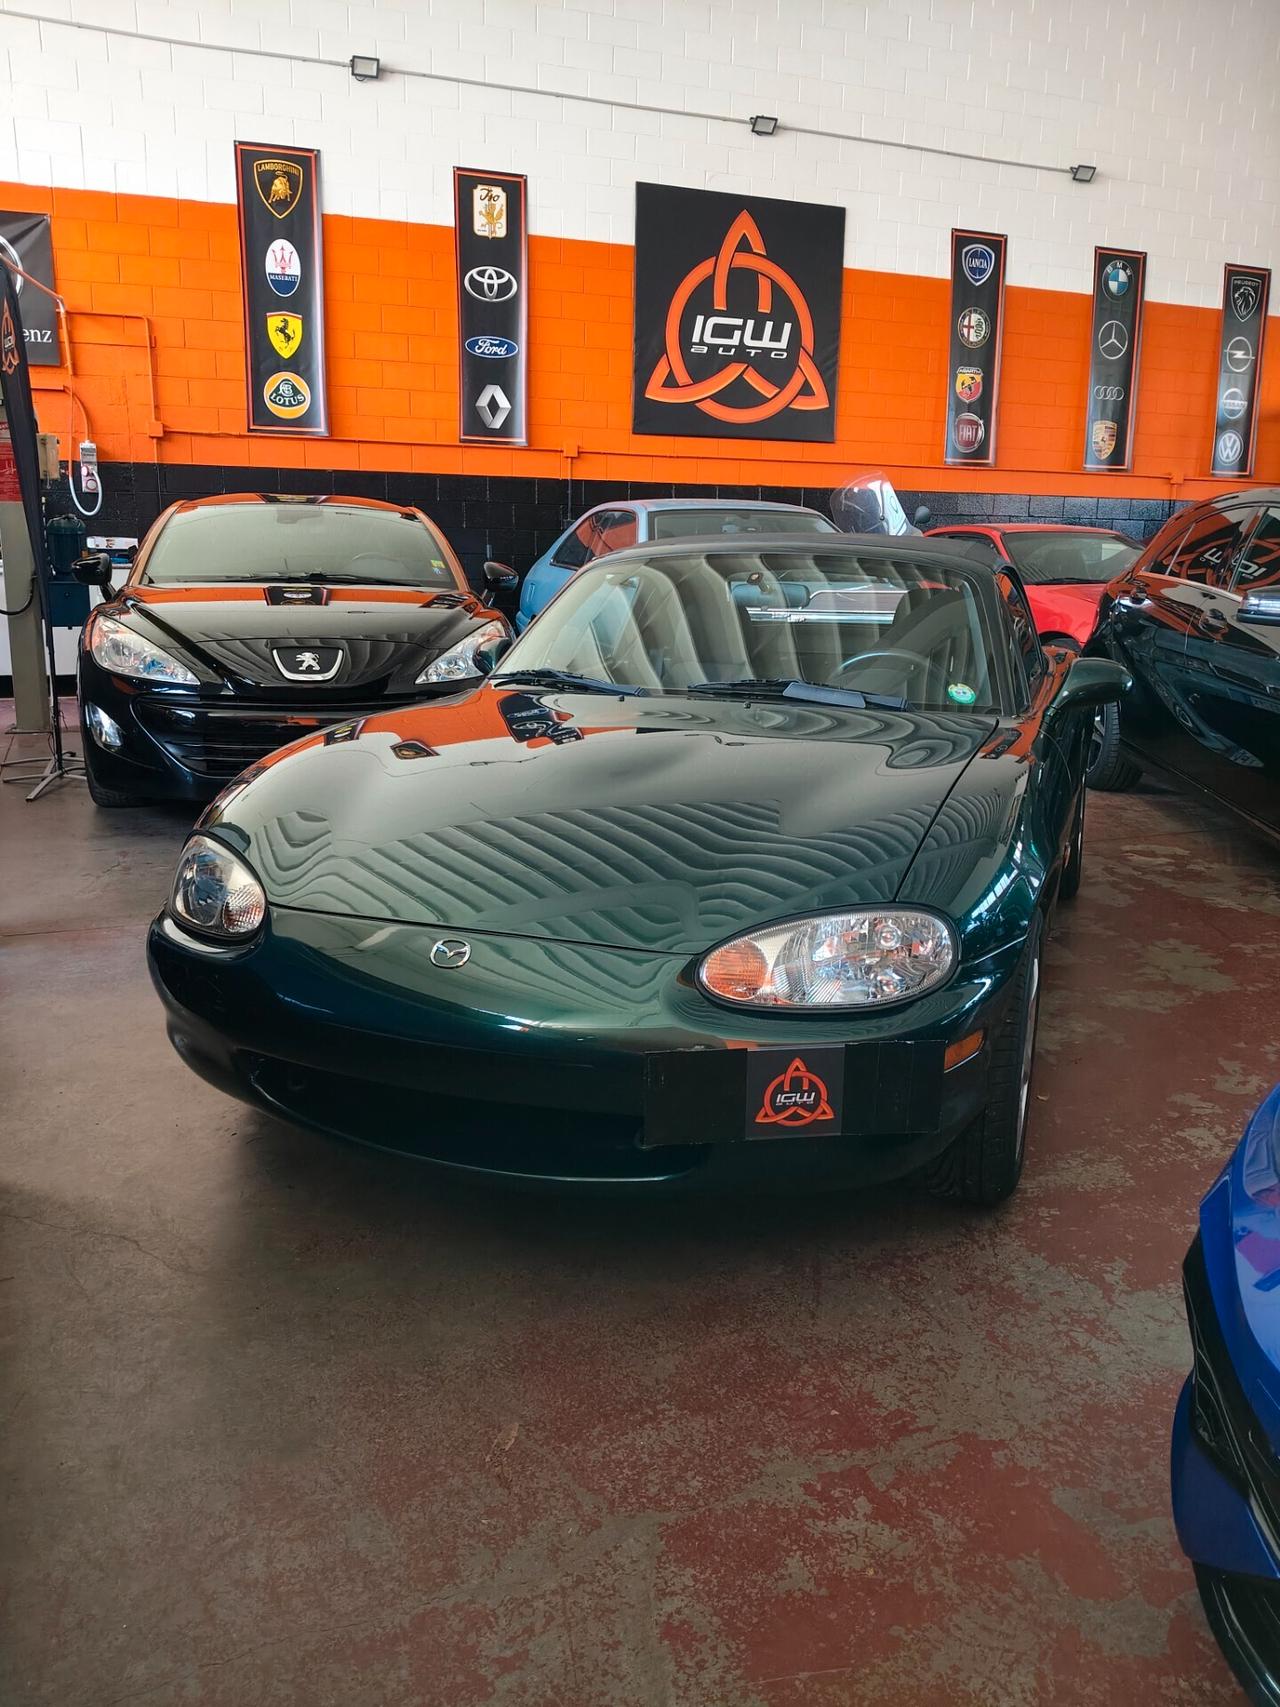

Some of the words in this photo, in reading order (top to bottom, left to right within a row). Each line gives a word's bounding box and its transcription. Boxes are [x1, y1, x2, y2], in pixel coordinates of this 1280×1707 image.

[257, 162, 300, 176] LAMBORGHINI
[968, 258, 988, 269] LANCIA
[269, 274, 299, 283] MASERATI
[23, 328, 53, 343] enz
[692, 315, 793, 349] IGW
[475, 339, 508, 355] Ford
[270, 392, 305, 406] LOTUS
[959, 424, 978, 442] FIAT
[776, 1092, 816, 1103] IGW
